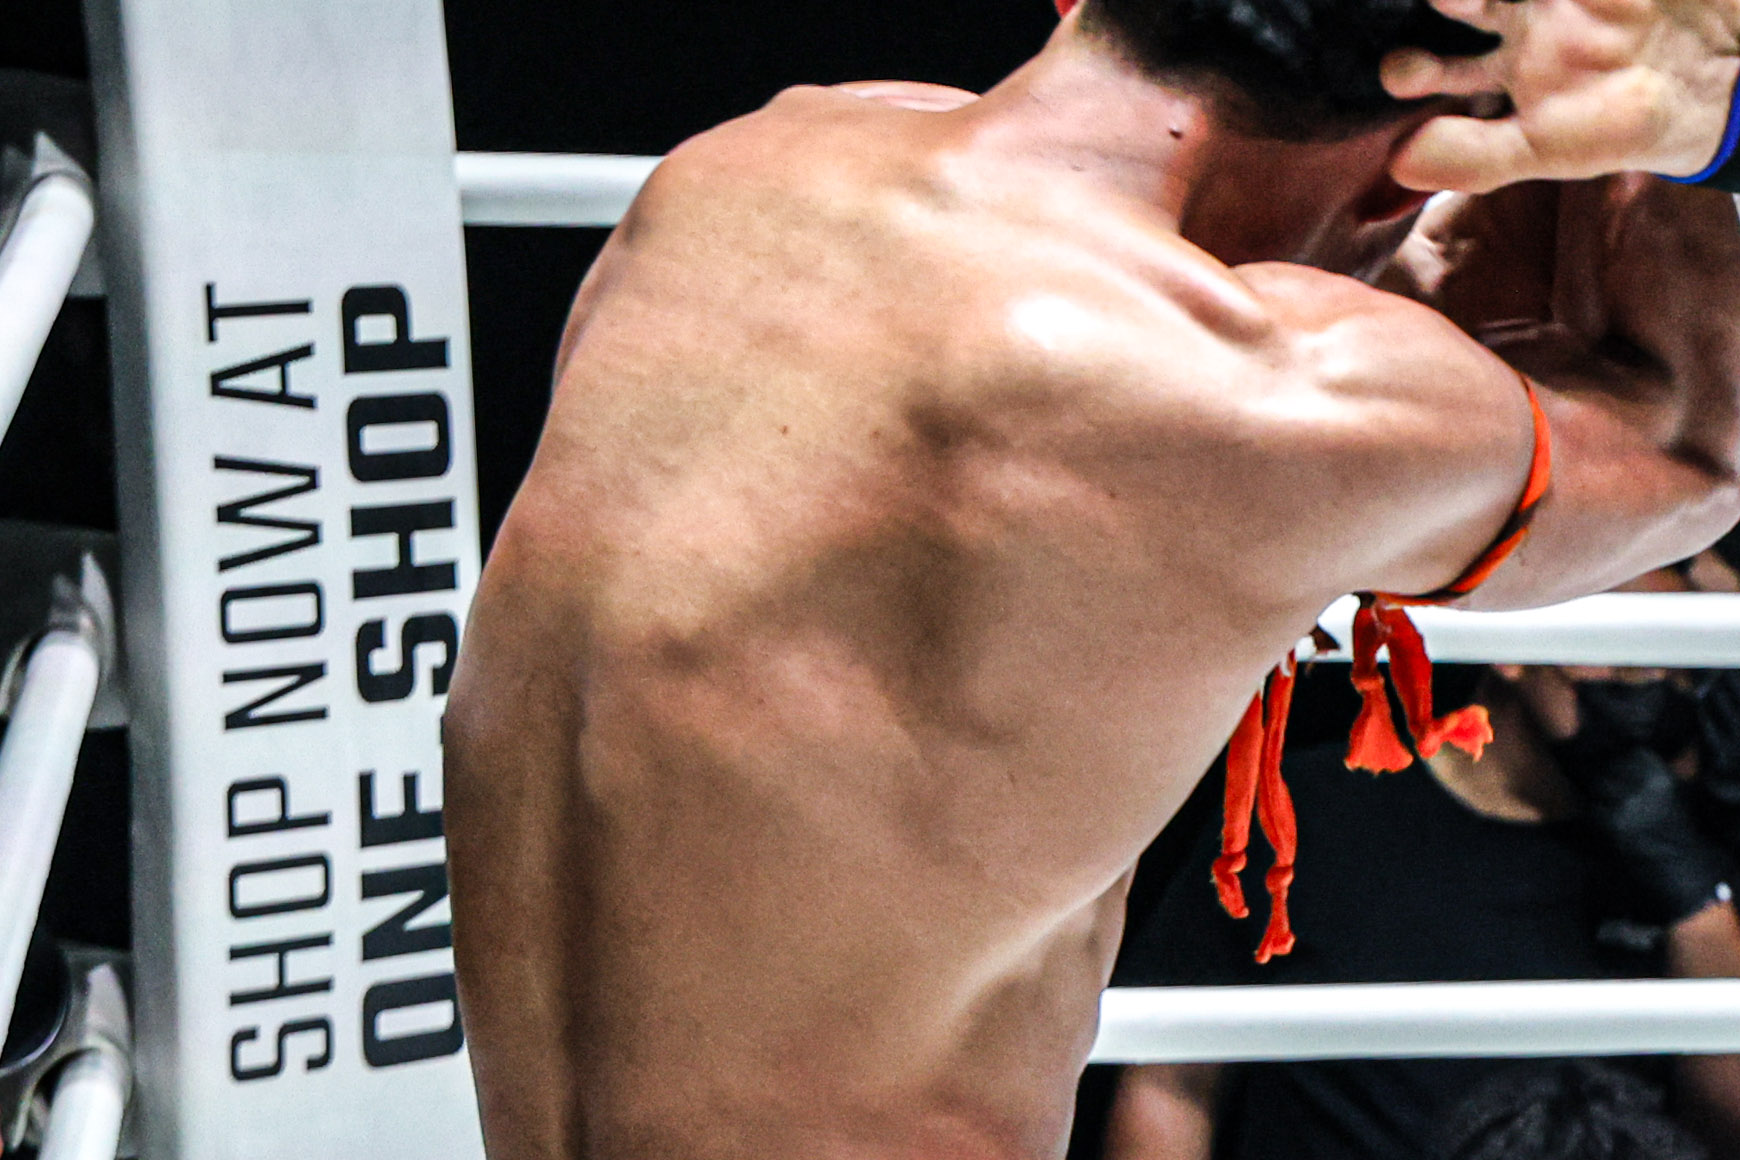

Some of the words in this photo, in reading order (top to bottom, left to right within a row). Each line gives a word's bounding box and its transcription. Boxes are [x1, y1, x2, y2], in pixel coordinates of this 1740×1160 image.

[204, 282, 318, 411] AT
[341, 283, 460, 706] SHOP
[213, 454, 330, 732] NOW
[226, 774, 334, 1083] SHOP
[359, 719, 465, 1071] ONE
